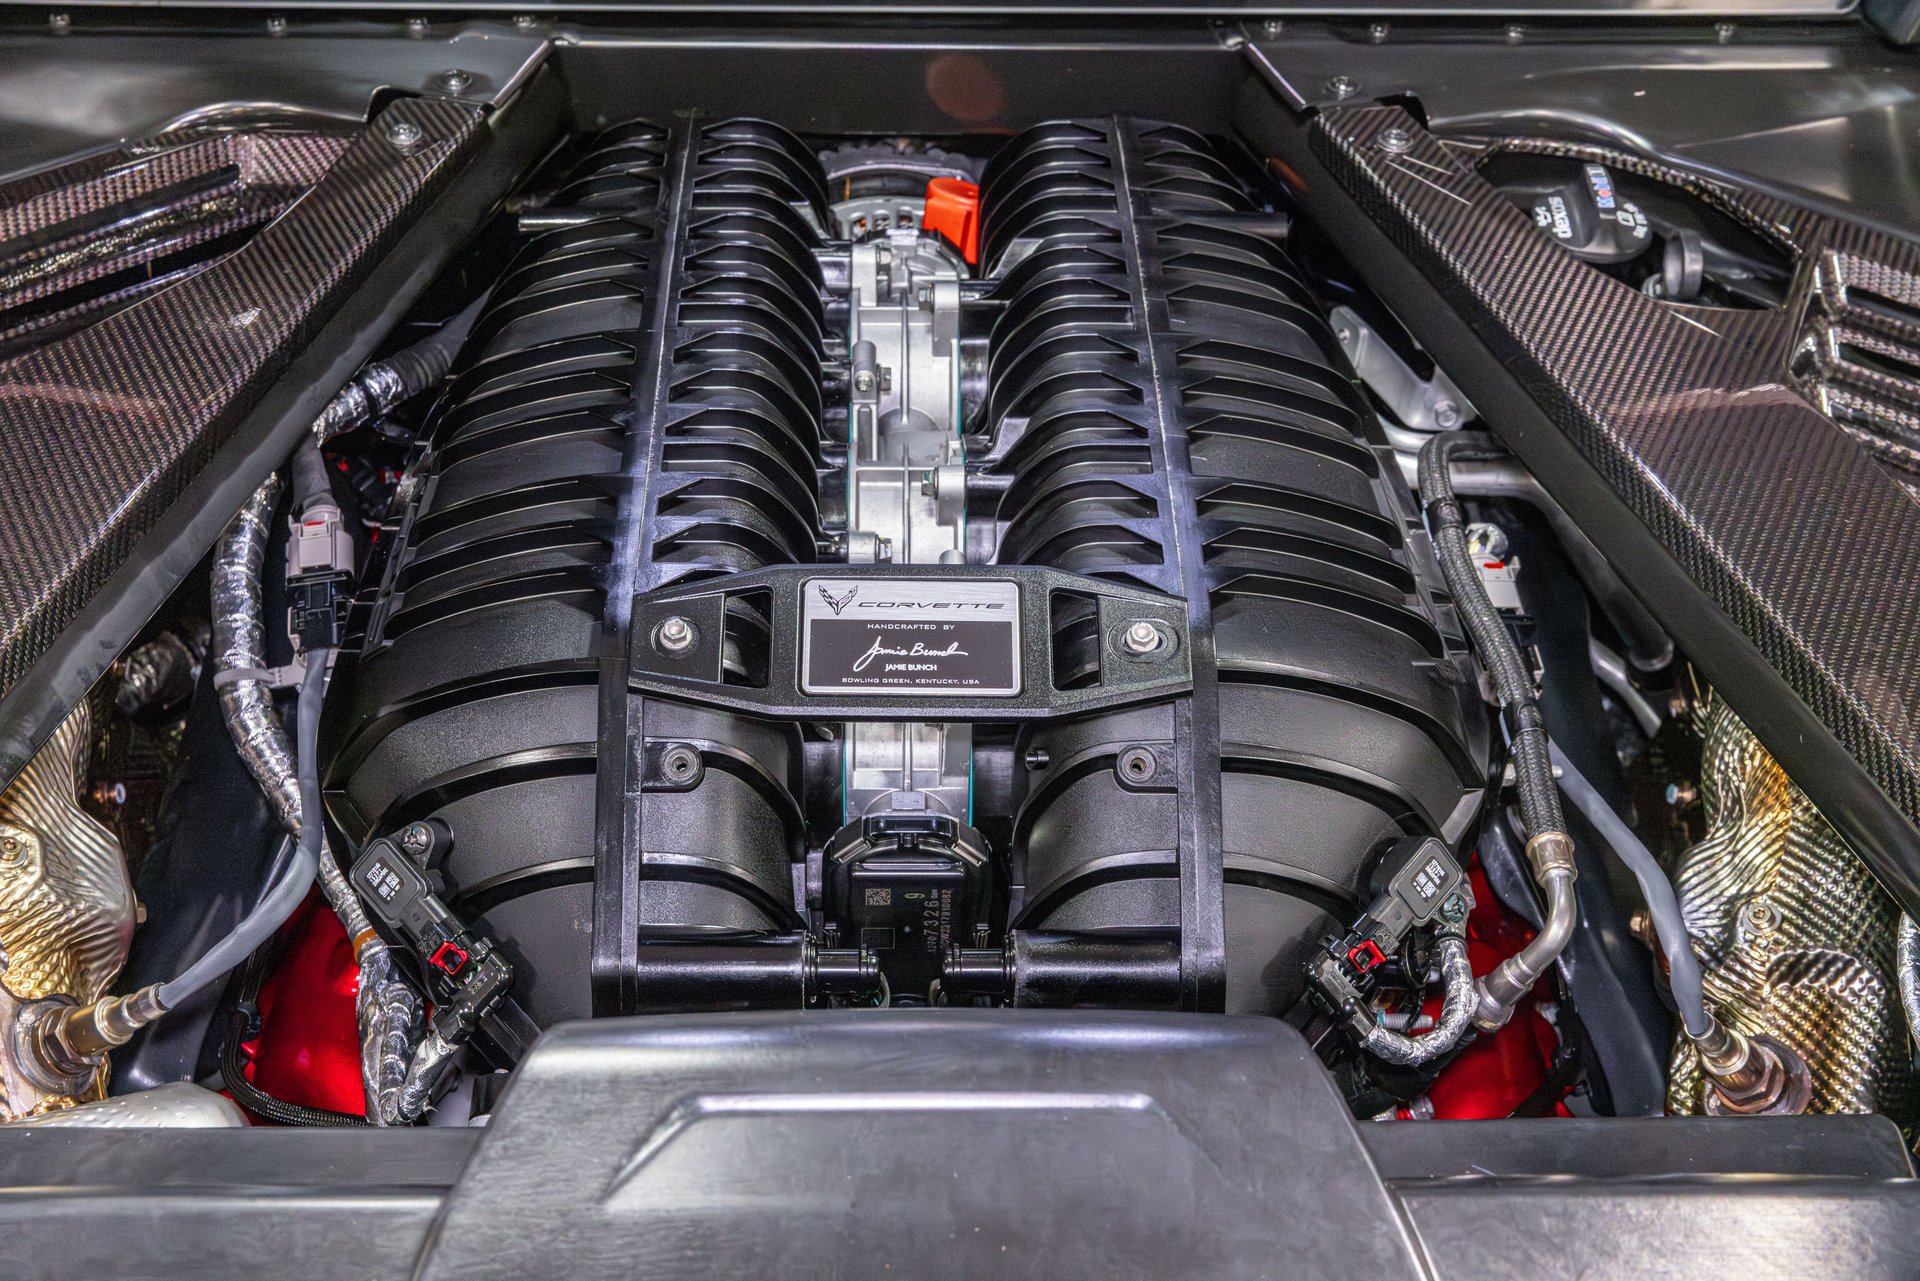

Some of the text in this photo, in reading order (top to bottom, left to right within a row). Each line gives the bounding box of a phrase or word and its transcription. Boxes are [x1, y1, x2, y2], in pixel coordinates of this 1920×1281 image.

[1547, 196, 1573, 238] dexos
[867, 623, 937, 631] HANDCRAFTED
[884, 663, 938, 673] JAMIE BUNCH
